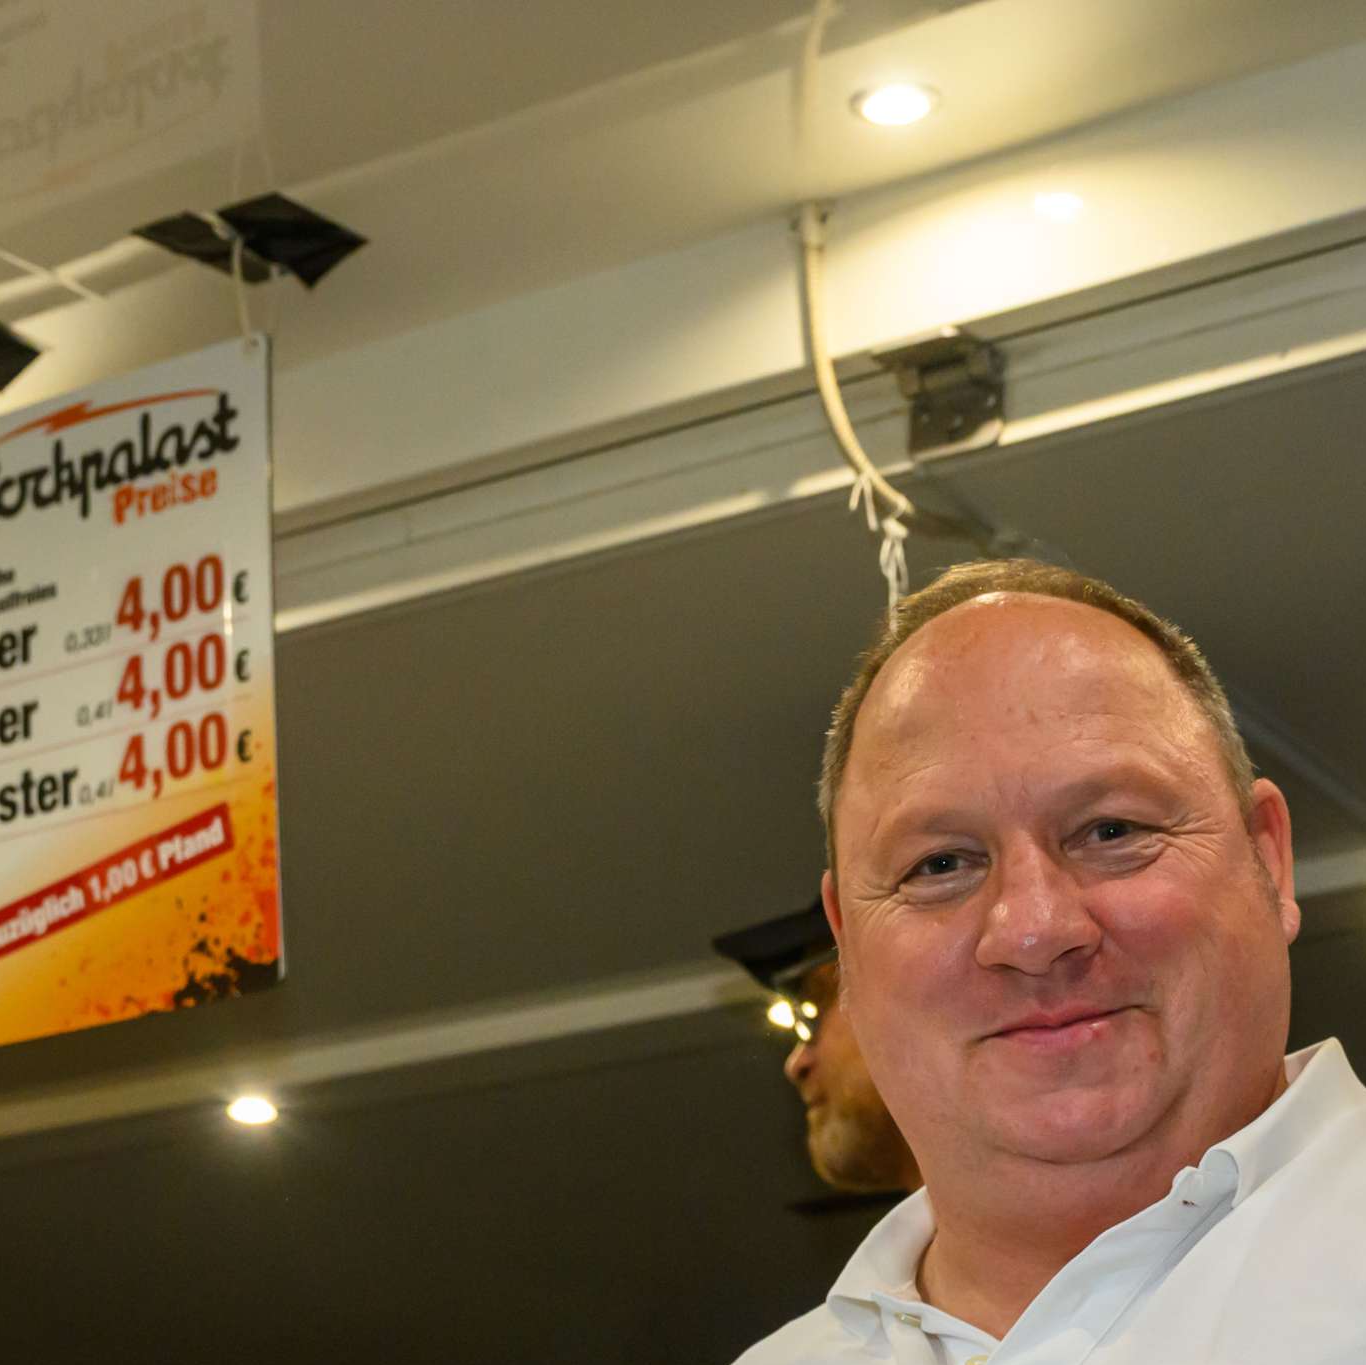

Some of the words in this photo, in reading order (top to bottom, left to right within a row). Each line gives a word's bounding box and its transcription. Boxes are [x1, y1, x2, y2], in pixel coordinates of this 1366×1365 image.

[112, 468, 218, 526] Preise
[115, 553, 224, 642] 4,00
[233, 570, 249, 603] €
[116, 633, 226, 720] 4,00
[234, 650, 250, 683] €
[118, 712, 228, 800] 4,00
[236, 729, 252, 763] €
[87, 868, 139, 904] 1,00
[156, 814, 225, 871] Pfand
